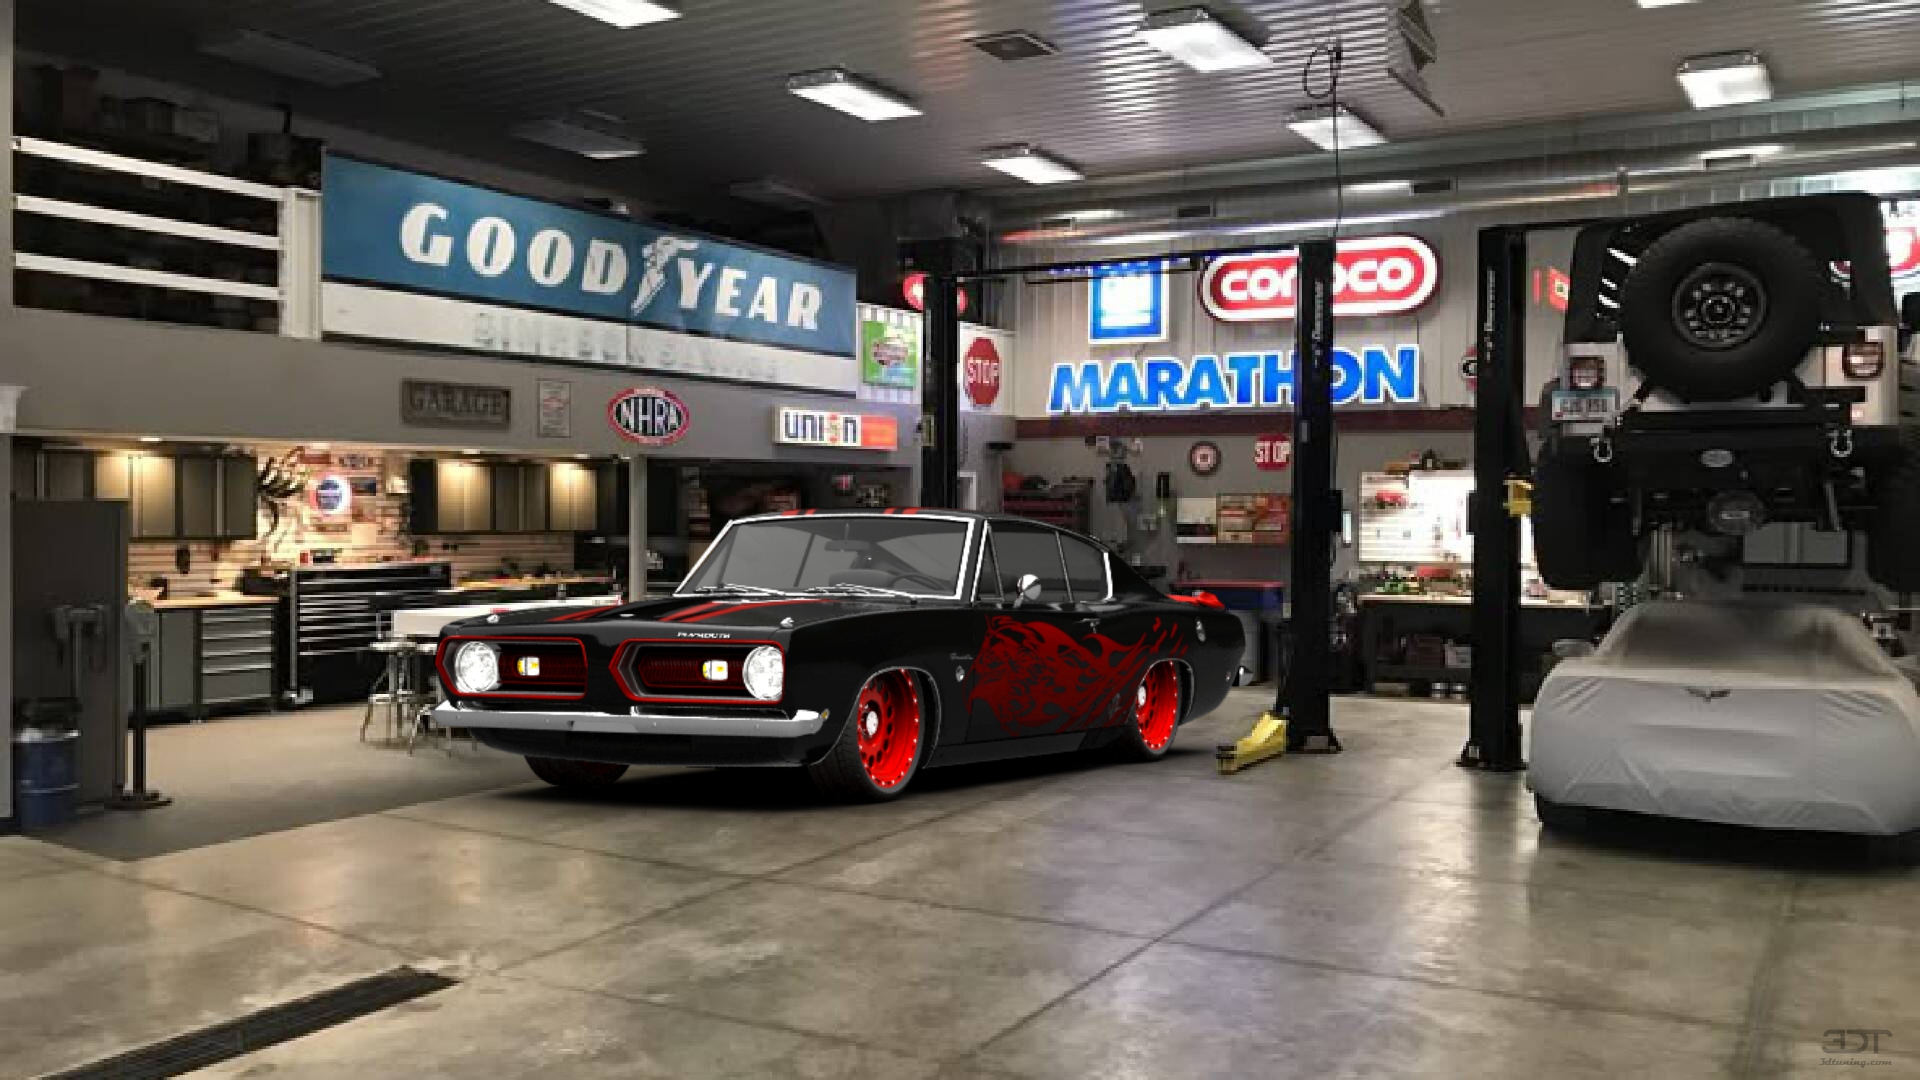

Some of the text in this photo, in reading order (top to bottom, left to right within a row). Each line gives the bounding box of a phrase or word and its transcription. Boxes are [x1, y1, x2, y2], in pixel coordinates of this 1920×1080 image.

[966, 356, 999, 384] STOP
[1051, 345, 1419, 411] MARATHON
[620, 397, 680, 435] NHRA
[1254, 440, 1291, 463] STOP
